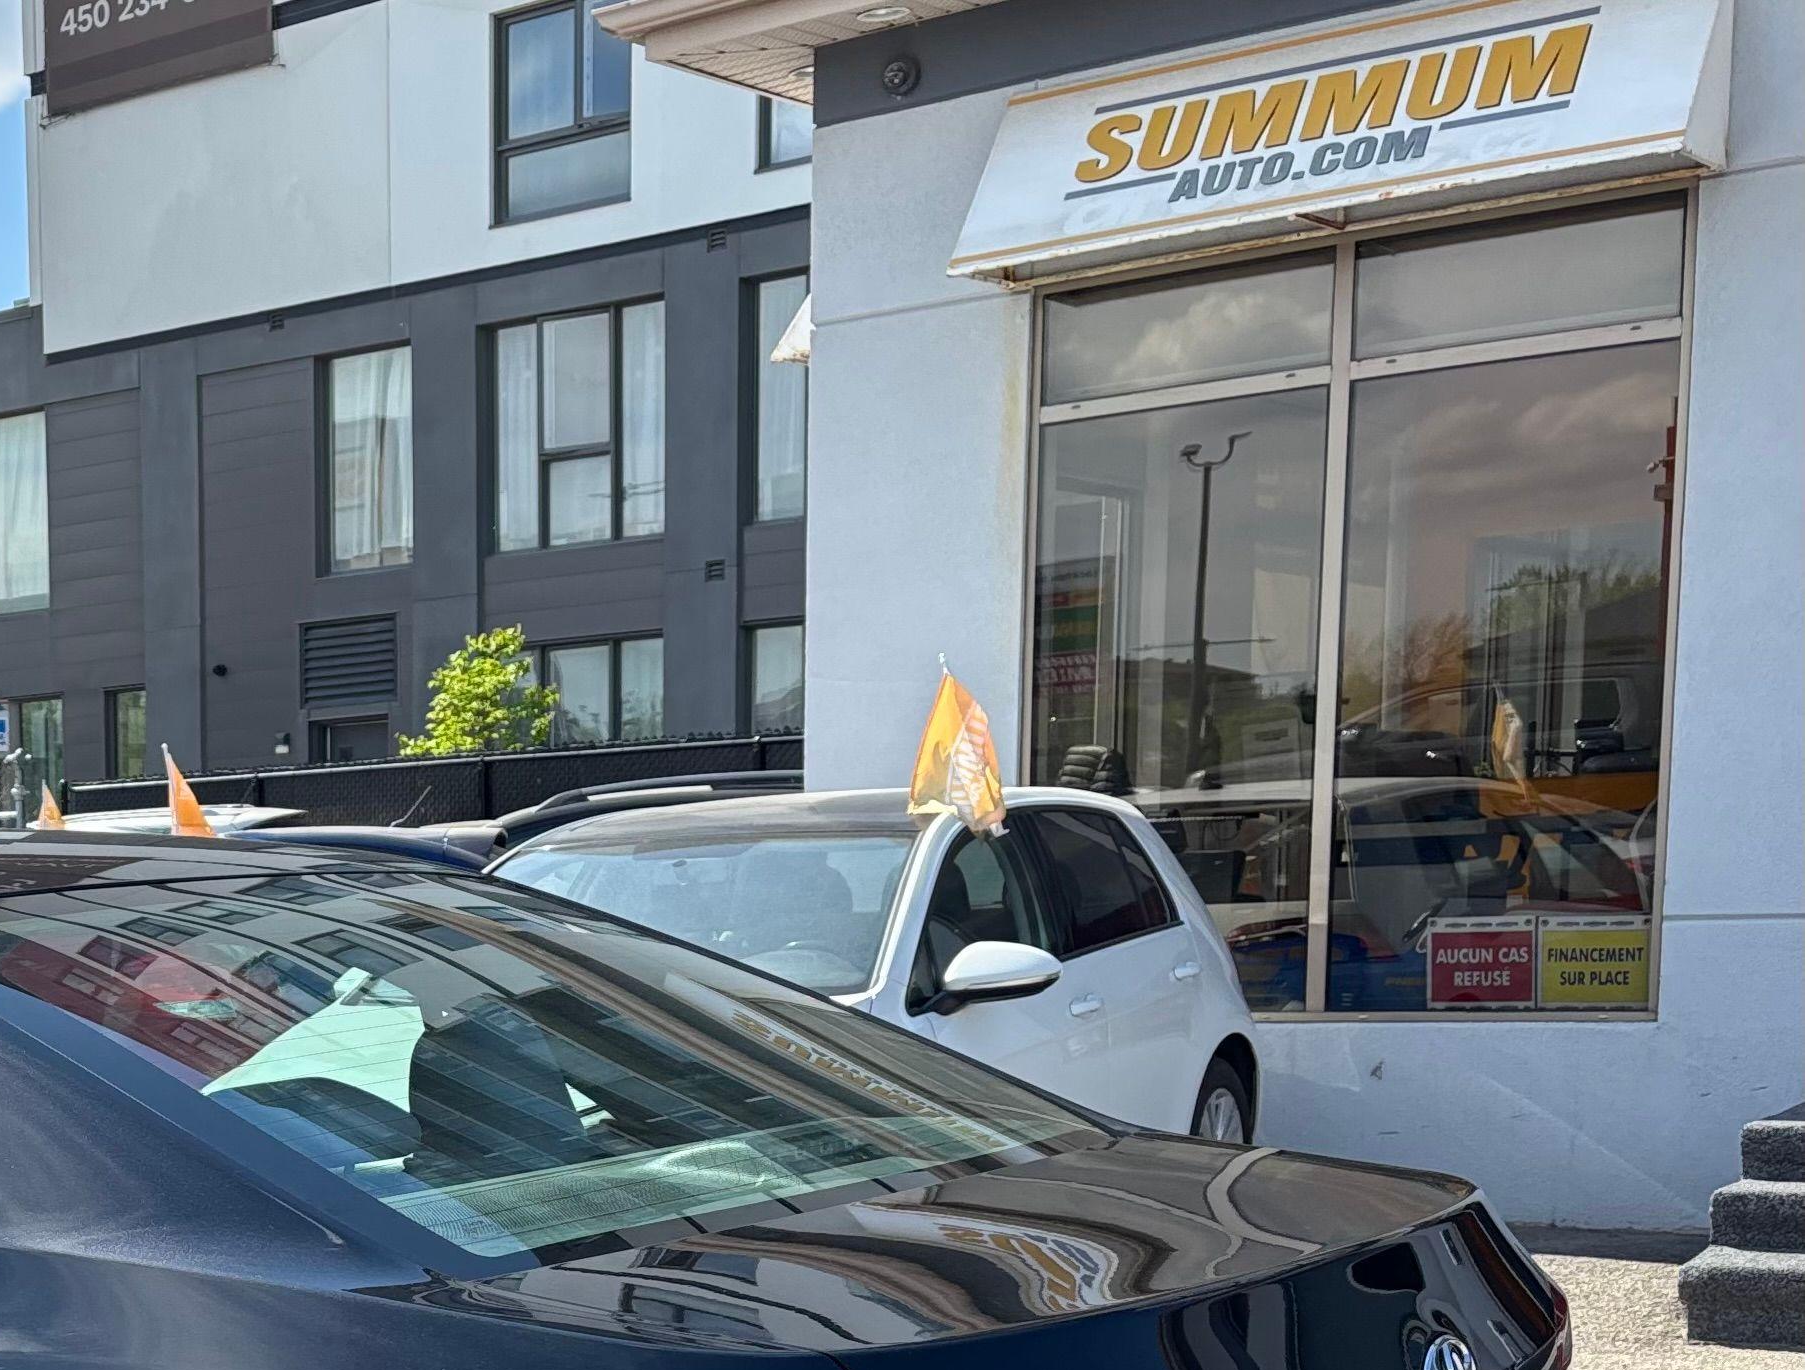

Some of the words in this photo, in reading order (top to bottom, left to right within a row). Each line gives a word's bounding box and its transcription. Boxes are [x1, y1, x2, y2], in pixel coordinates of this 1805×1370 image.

[60, 0, 110, 36] 450
[1073, 23, 1593, 183] SUMMUM
[1166, 123, 1433, 203] AUTO.COM
[1435, 948, 1494, 964] AUCUN
[1498, 947, 1529, 964] CAS
[1547, 947, 1644, 963] FINANCEMENT
[1454, 966, 1511, 987] REFUSÉ
[1560, 970, 1586, 986] SUR
[1590, 970, 1630, 986] PLACE
